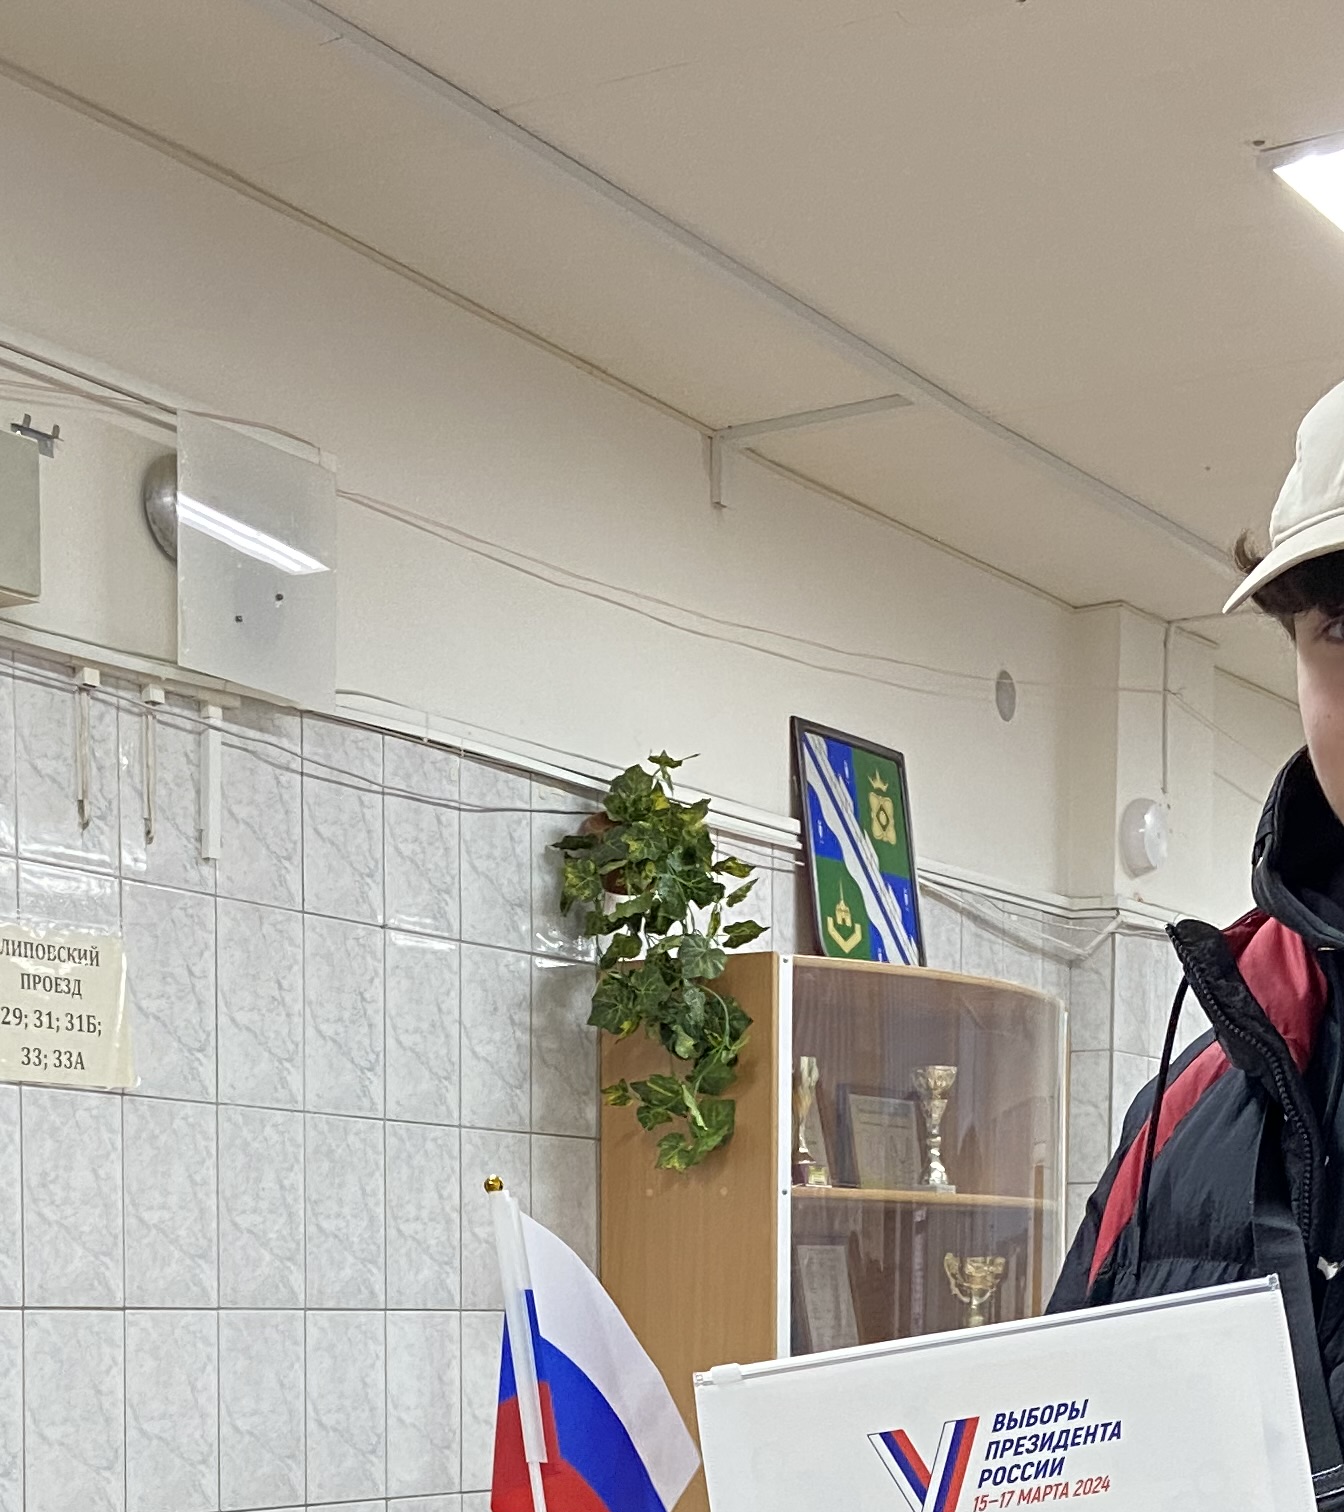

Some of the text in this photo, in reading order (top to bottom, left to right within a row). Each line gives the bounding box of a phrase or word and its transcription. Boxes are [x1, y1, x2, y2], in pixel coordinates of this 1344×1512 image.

[20, 972, 83, 1000] ПРОЕЗД
[0, 1006, 102, 1037] 29; 31; 31Б;
[20, 1046, 86, 1071] 33; 33А
[991, 1398, 1090, 1433] ВЫБОРЫ
[984, 1420, 1123, 1461] ПРЕЗИДЕНТА
[977, 1456, 1066, 1489] РОССИИ
[1017, 1482, 1070, 1506] МАРТА
[1071, 1475, 1111, 1498] 2024
